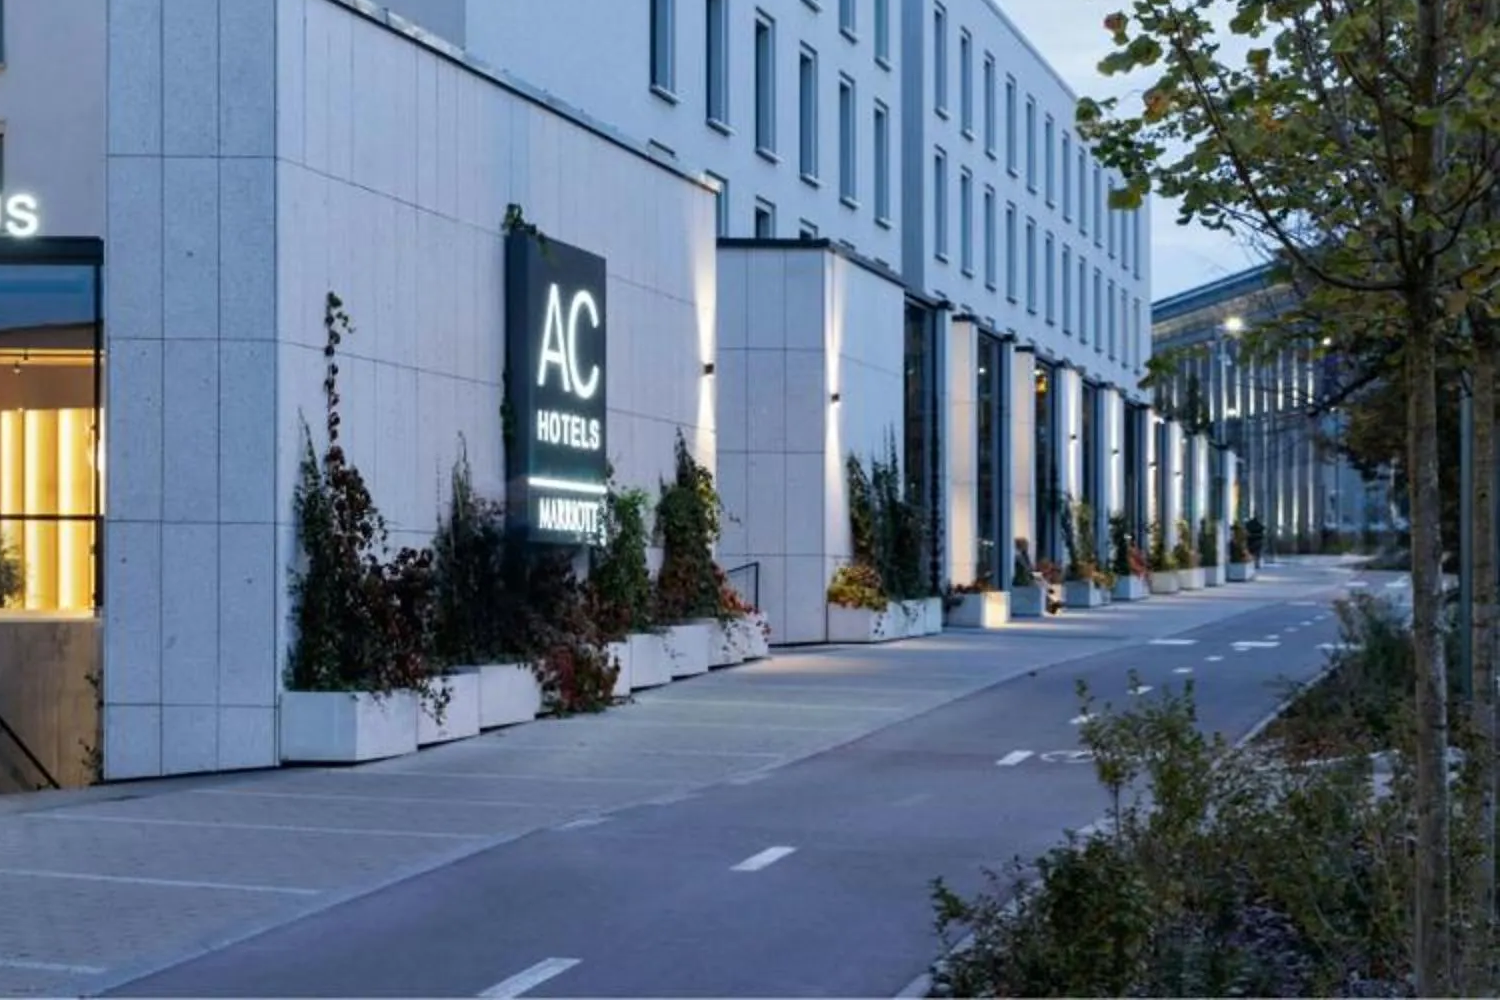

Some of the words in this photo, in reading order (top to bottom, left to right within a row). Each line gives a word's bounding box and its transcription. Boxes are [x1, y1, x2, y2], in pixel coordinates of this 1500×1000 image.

[537, 283, 599, 399] AC
[537, 410, 599, 449] HOTELS
[539, 497, 598, 532] MARRIOTT
